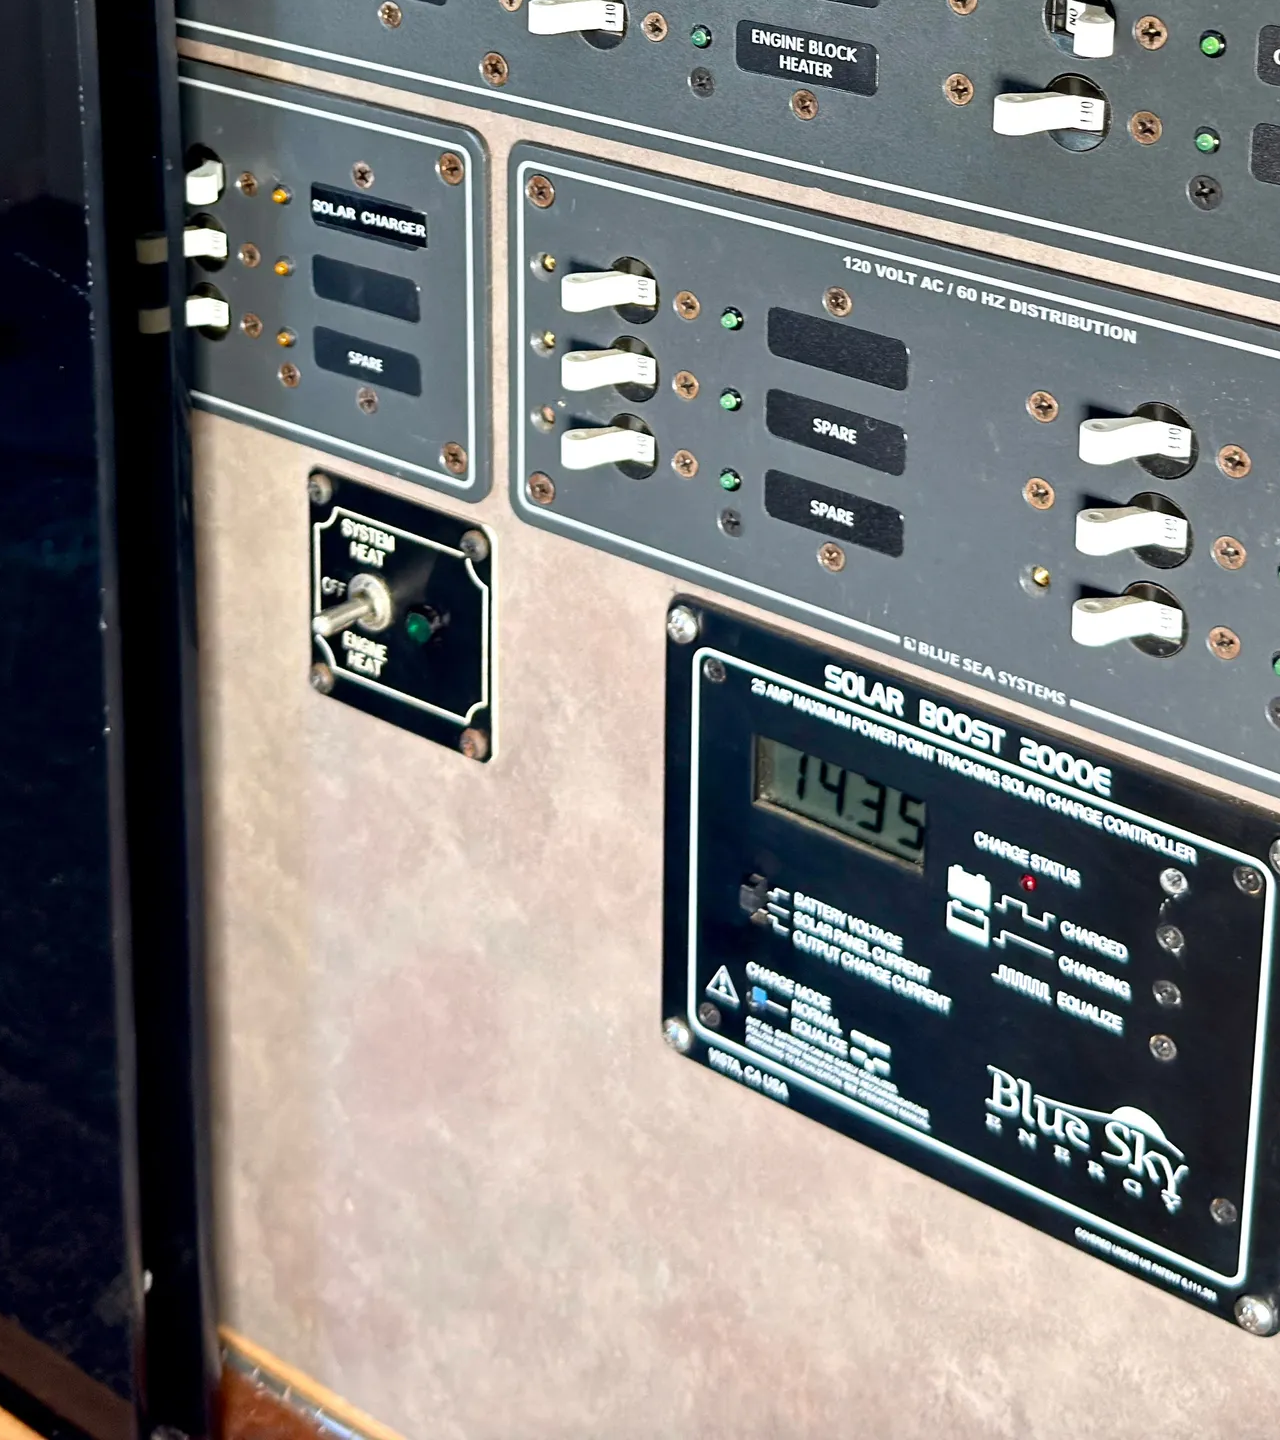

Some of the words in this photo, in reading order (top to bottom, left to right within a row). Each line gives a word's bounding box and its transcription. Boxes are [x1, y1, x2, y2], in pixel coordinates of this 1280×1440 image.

[751, 28, 805, 53] ENGINE
[808, 38, 858, 64] BLOCK
[779, 54, 833, 79] HEATER
[312, 198, 357, 221] SOLAR
[361, 211, 427, 238] CHARGER
[842, 255, 872, 274] 120
[874, 263, 918, 286] VOLT
[920, 276, 945, 294] AC
[956, 286, 978, 303] 60
[980, 291, 1006, 310] HZ
[1009, 298, 1138, 345] DISTRIBUTION
[347, 350, 384, 373] SPARE
[812, 416, 858, 445] SPARE
[340, 517, 396, 553] SYSTEM
[809, 498, 856, 528] SPARE
[349, 540, 386, 569] HEAT
[321, 575, 347, 598] OFF
[346, 649, 385, 679] HEAT
[917, 641, 960, 668] BLUE
[962, 658, 996, 683] SEA
[998, 669, 1067, 707] SYSTEMS
[823, 663, 905, 718] SOLAR
[918, 698, 1007, 756] BOOST
[1019, 735, 1113, 798] 2000E
[765, 683, 794, 707] AMP
[792, 693, 853, 731] MAXIMUM
[851, 715, 899, 749] POWER
[897, 733, 935, 763] POINT
[934, 746, 1002, 791] TRACKING
[1000, 772, 1046, 809] SOLAR
[1045, 791, 1104, 830] CHARGE
[1102, 813, 1199, 869] CONTROLLER
[972, 830, 1031, 868] CHARGE
[1030, 851, 1083, 890] STATUS
[792, 891, 848, 930] BATTERY
[846, 912, 904, 955] VOLTAGE
[1058, 920, 1130, 964] CHARGED
[792, 910, 835, 942] SOLAR
[832, 928, 873, 960] PANEL
[870, 945, 933, 988] CURRENT
[744, 960, 796, 998] CHARGE
[793, 982, 833, 1015] MODE
[792, 929, 842, 966] OUTPUT
[840, 950, 894, 992] CHARGE
[890, 973, 953, 1019] CURRENT
[1058, 955, 1132, 1003] CHARGING
[790, 998, 844, 1038] NORMAL
[1055, 990, 1125, 1038] EQUALIZE
[790, 1016, 849, 1060] EQUALIZE
[984, 1063, 1091, 1154] Blue
[1100, 1118, 1190, 1200] Sky
